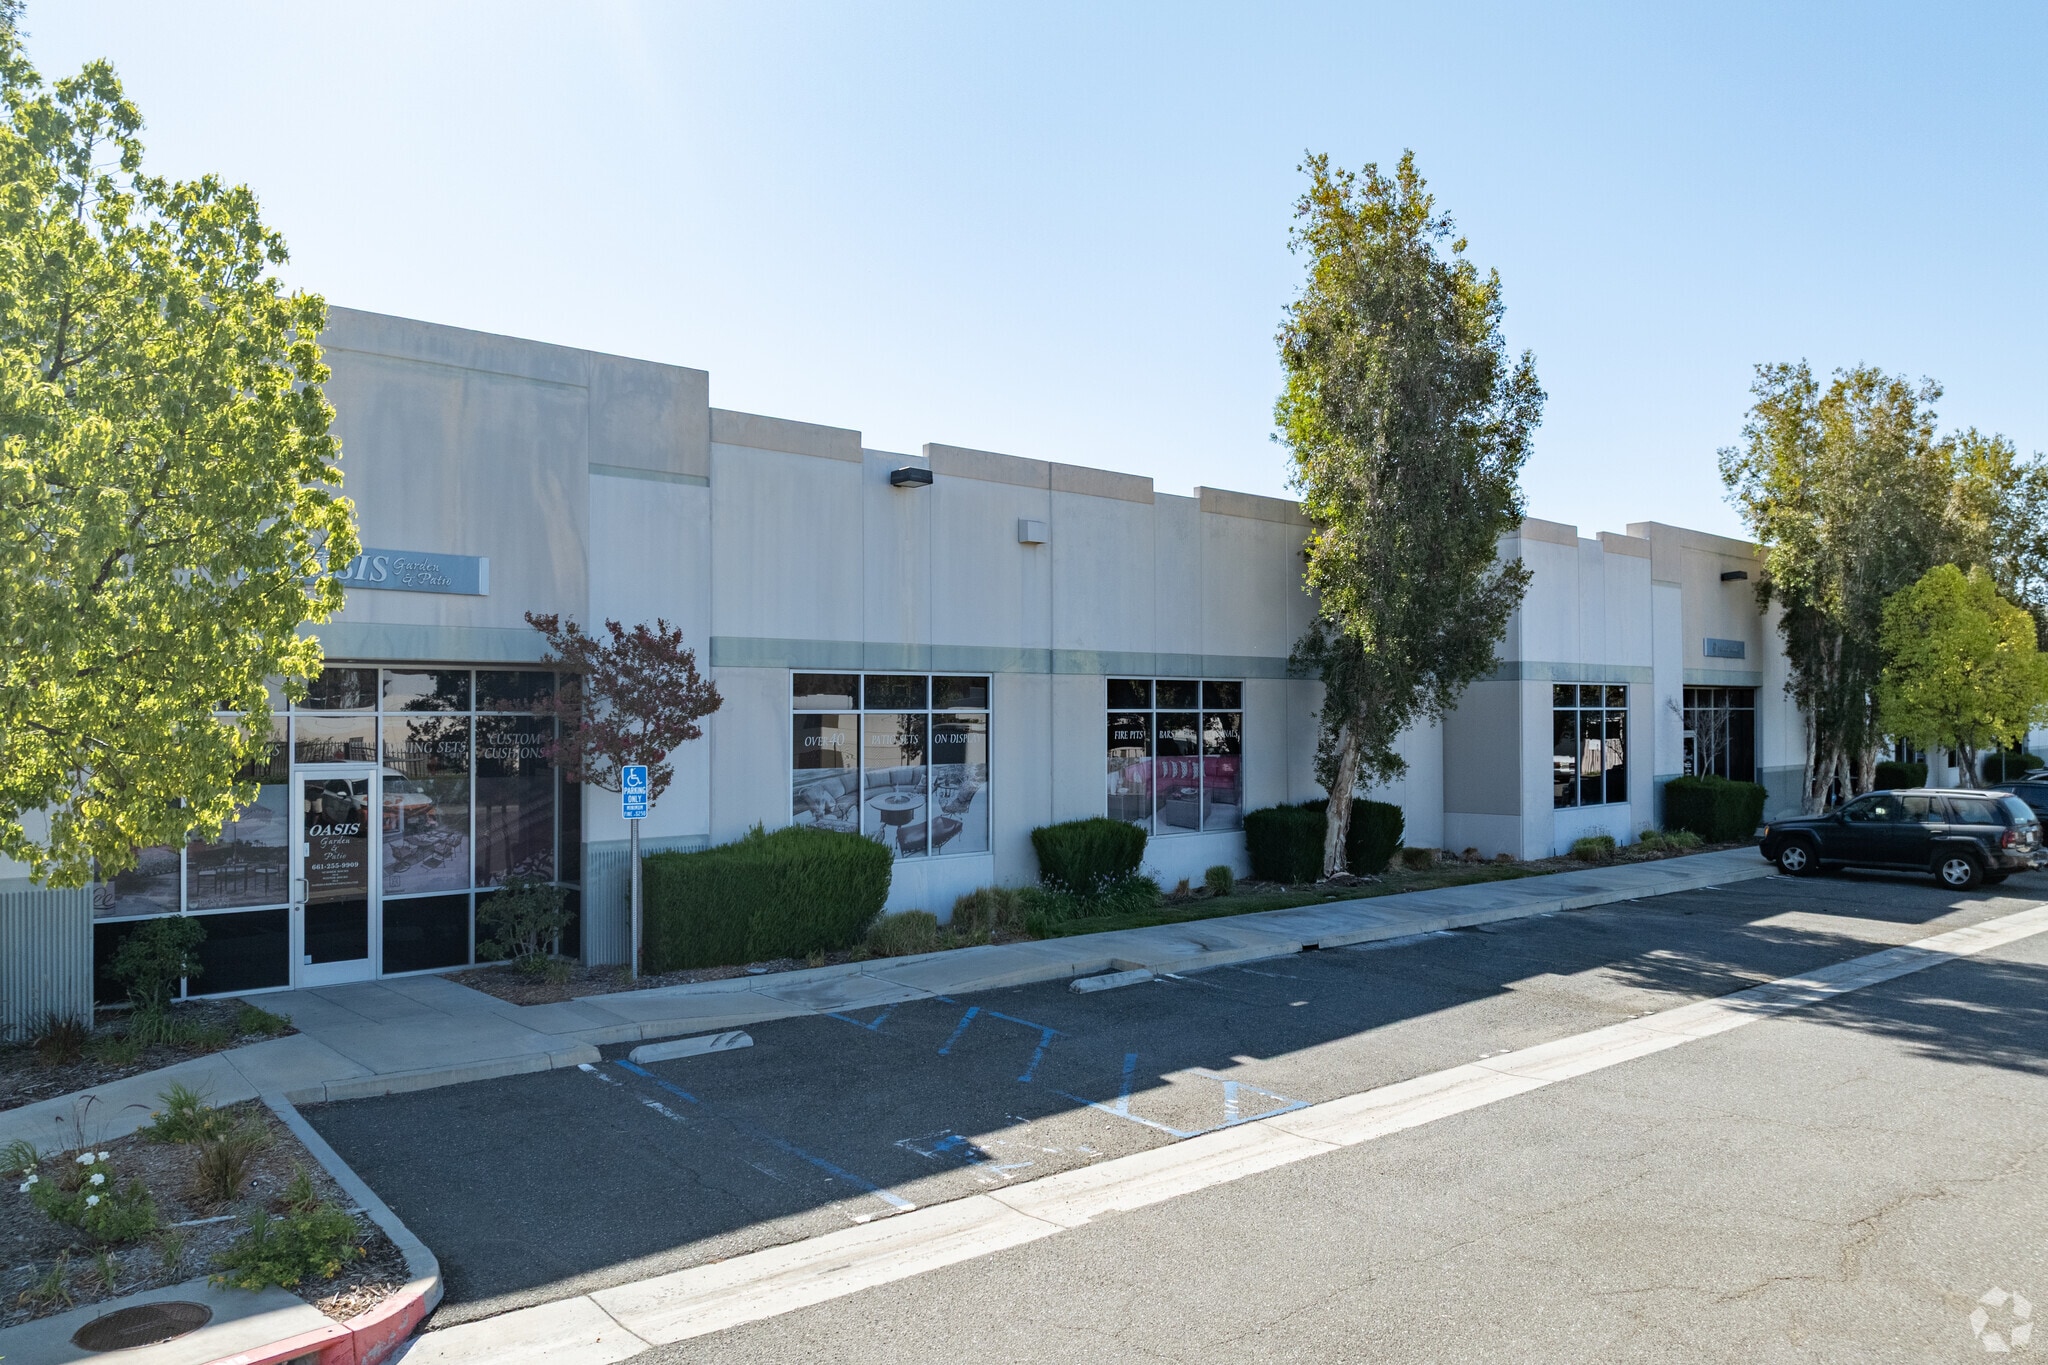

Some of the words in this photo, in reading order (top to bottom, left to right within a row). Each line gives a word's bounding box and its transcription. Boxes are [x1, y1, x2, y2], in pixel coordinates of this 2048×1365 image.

[392, 557, 440, 575] Garden
[402, 573, 414, 587] &
[417, 572, 452, 586] Patio
[489, 733, 541, 745] CUSTOM
[804, 736, 828, 747] OVER
[830, 733, 845, 746] 40
[871, 735, 896, 745] PATIO
[899, 734, 919, 745] SETS
[934, 733, 948, 744] ON
[1114, 730, 1129, 740] FIRE
[1129, 730, 1144, 740] PITS
[436, 740, 468, 754] SETS
[484, 747, 546, 759] CUSHONS
[309, 823, 361, 837] OASIS
[320, 836, 351, 849] Garden
[324, 852, 347, 860] Patio
